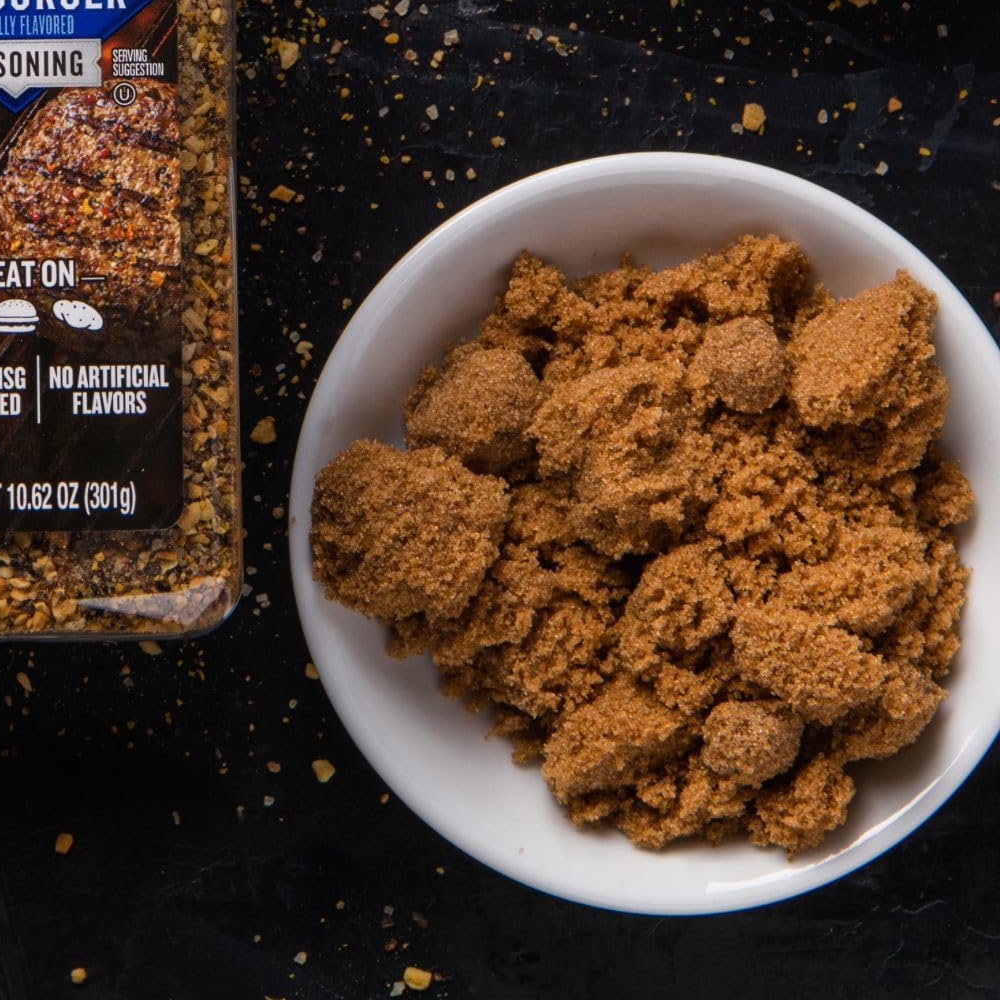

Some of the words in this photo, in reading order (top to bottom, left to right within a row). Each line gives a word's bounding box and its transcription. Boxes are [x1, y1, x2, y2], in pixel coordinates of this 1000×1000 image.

[20, 15, 75, 35] FLAVORED
[112, 49, 148, 62] SERVING
[112, 63, 164, 76] SUGGESTION
[42, 260, 75, 287] ON
[49, 366, 74, 389] NO
[77, 365, 169, 388] ARTIFICIAL
[72, 392, 147, 414] FLAVORS
[7, 483, 52, 510] 10.62
[57, 483, 80, 509] OZ
[84, 482, 136, 515] (301g)
